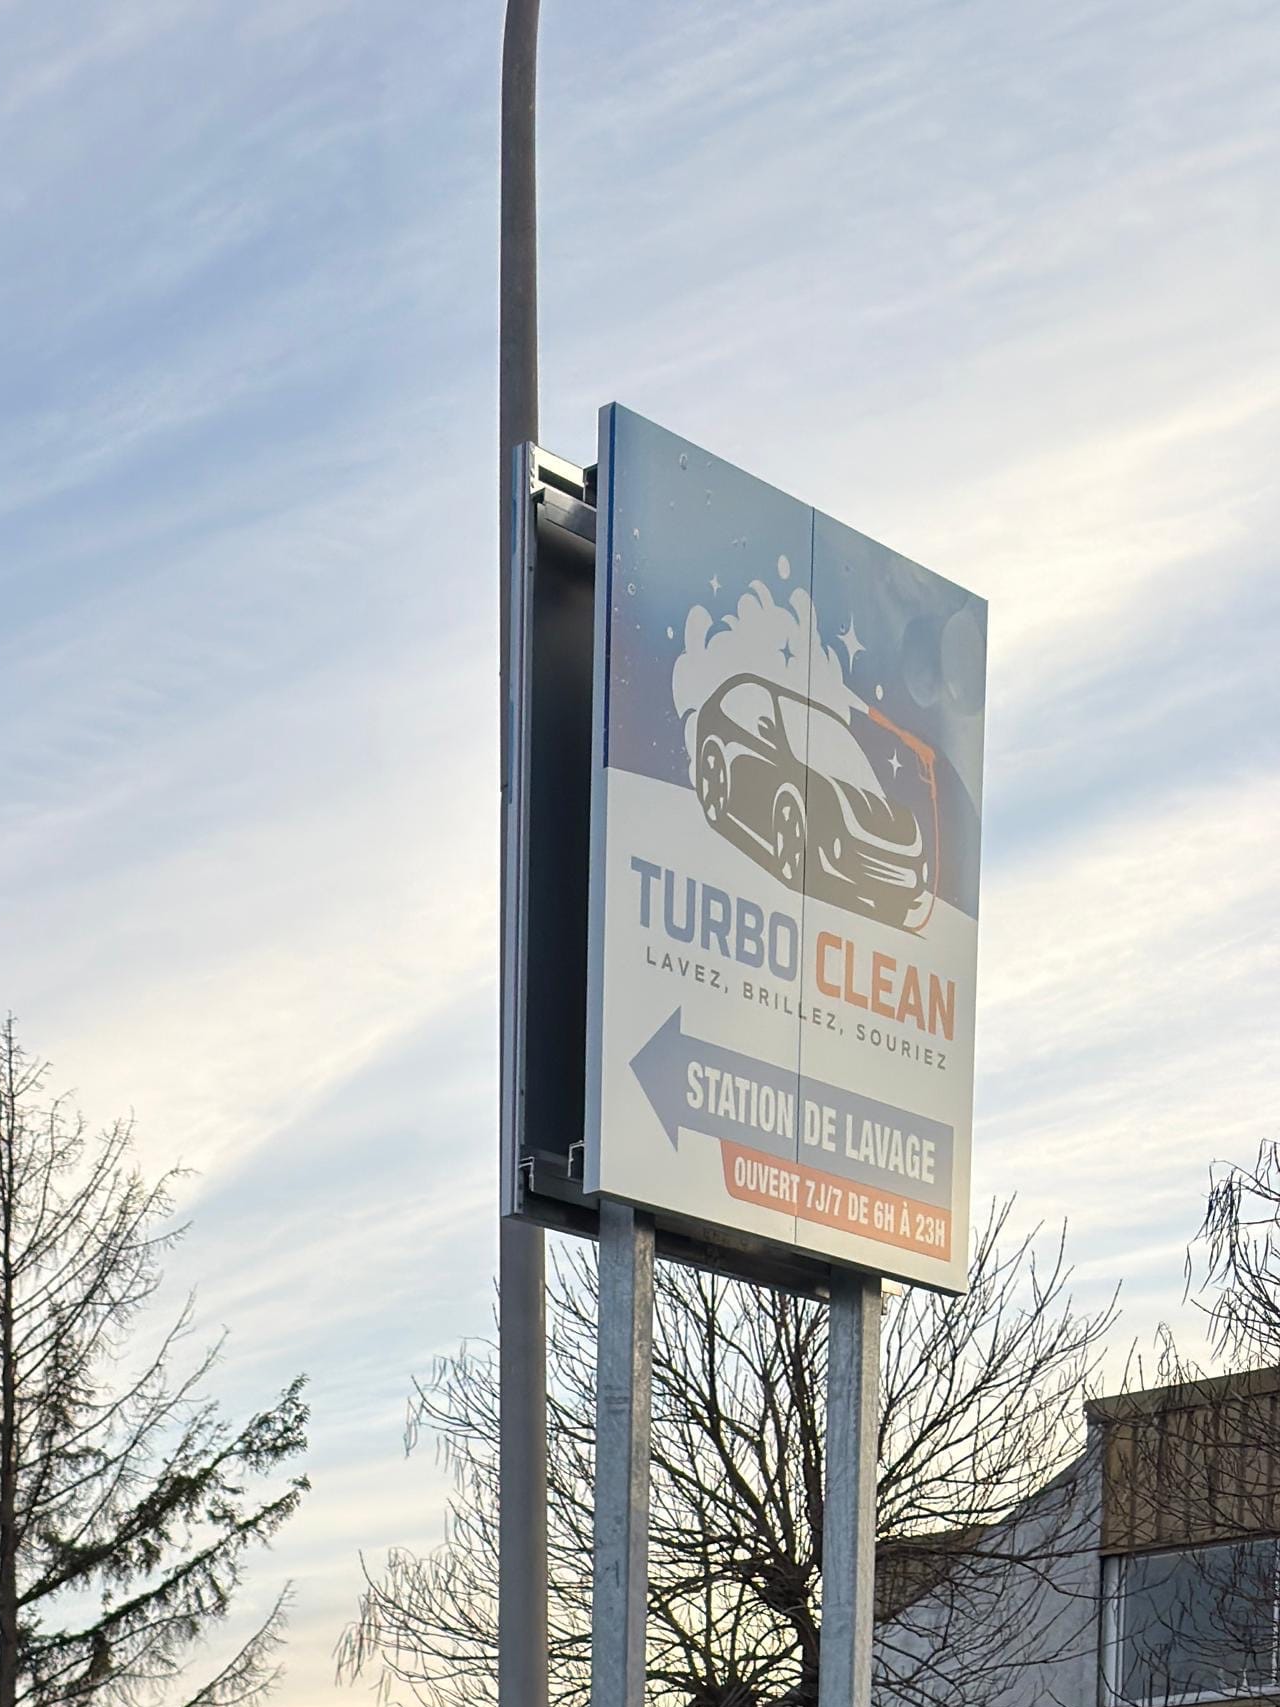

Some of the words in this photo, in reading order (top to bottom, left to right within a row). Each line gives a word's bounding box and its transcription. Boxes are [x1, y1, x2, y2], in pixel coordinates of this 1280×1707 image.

[630, 856, 799, 984] TURBO
[815, 929, 957, 1042] CLEAN
[646, 944, 730, 995] LAVEZ,
[742, 982, 844, 1037] BRILLEZ,
[856, 1023, 949, 1071] SOURIEZ
[685, 1060, 794, 1141] STATION
[803, 1094, 838, 1152] DE
[845, 1105, 937, 1185] LAVAGE
[733, 1155, 800, 1205] OUVERT
[805, 1177, 844, 1221] 7J/7
[847, 1188, 870, 1226] DE
[875, 1195, 896, 1232] 6H
[899, 1195, 914, 1236] À
[916, 1204, 947, 1248] 23H
